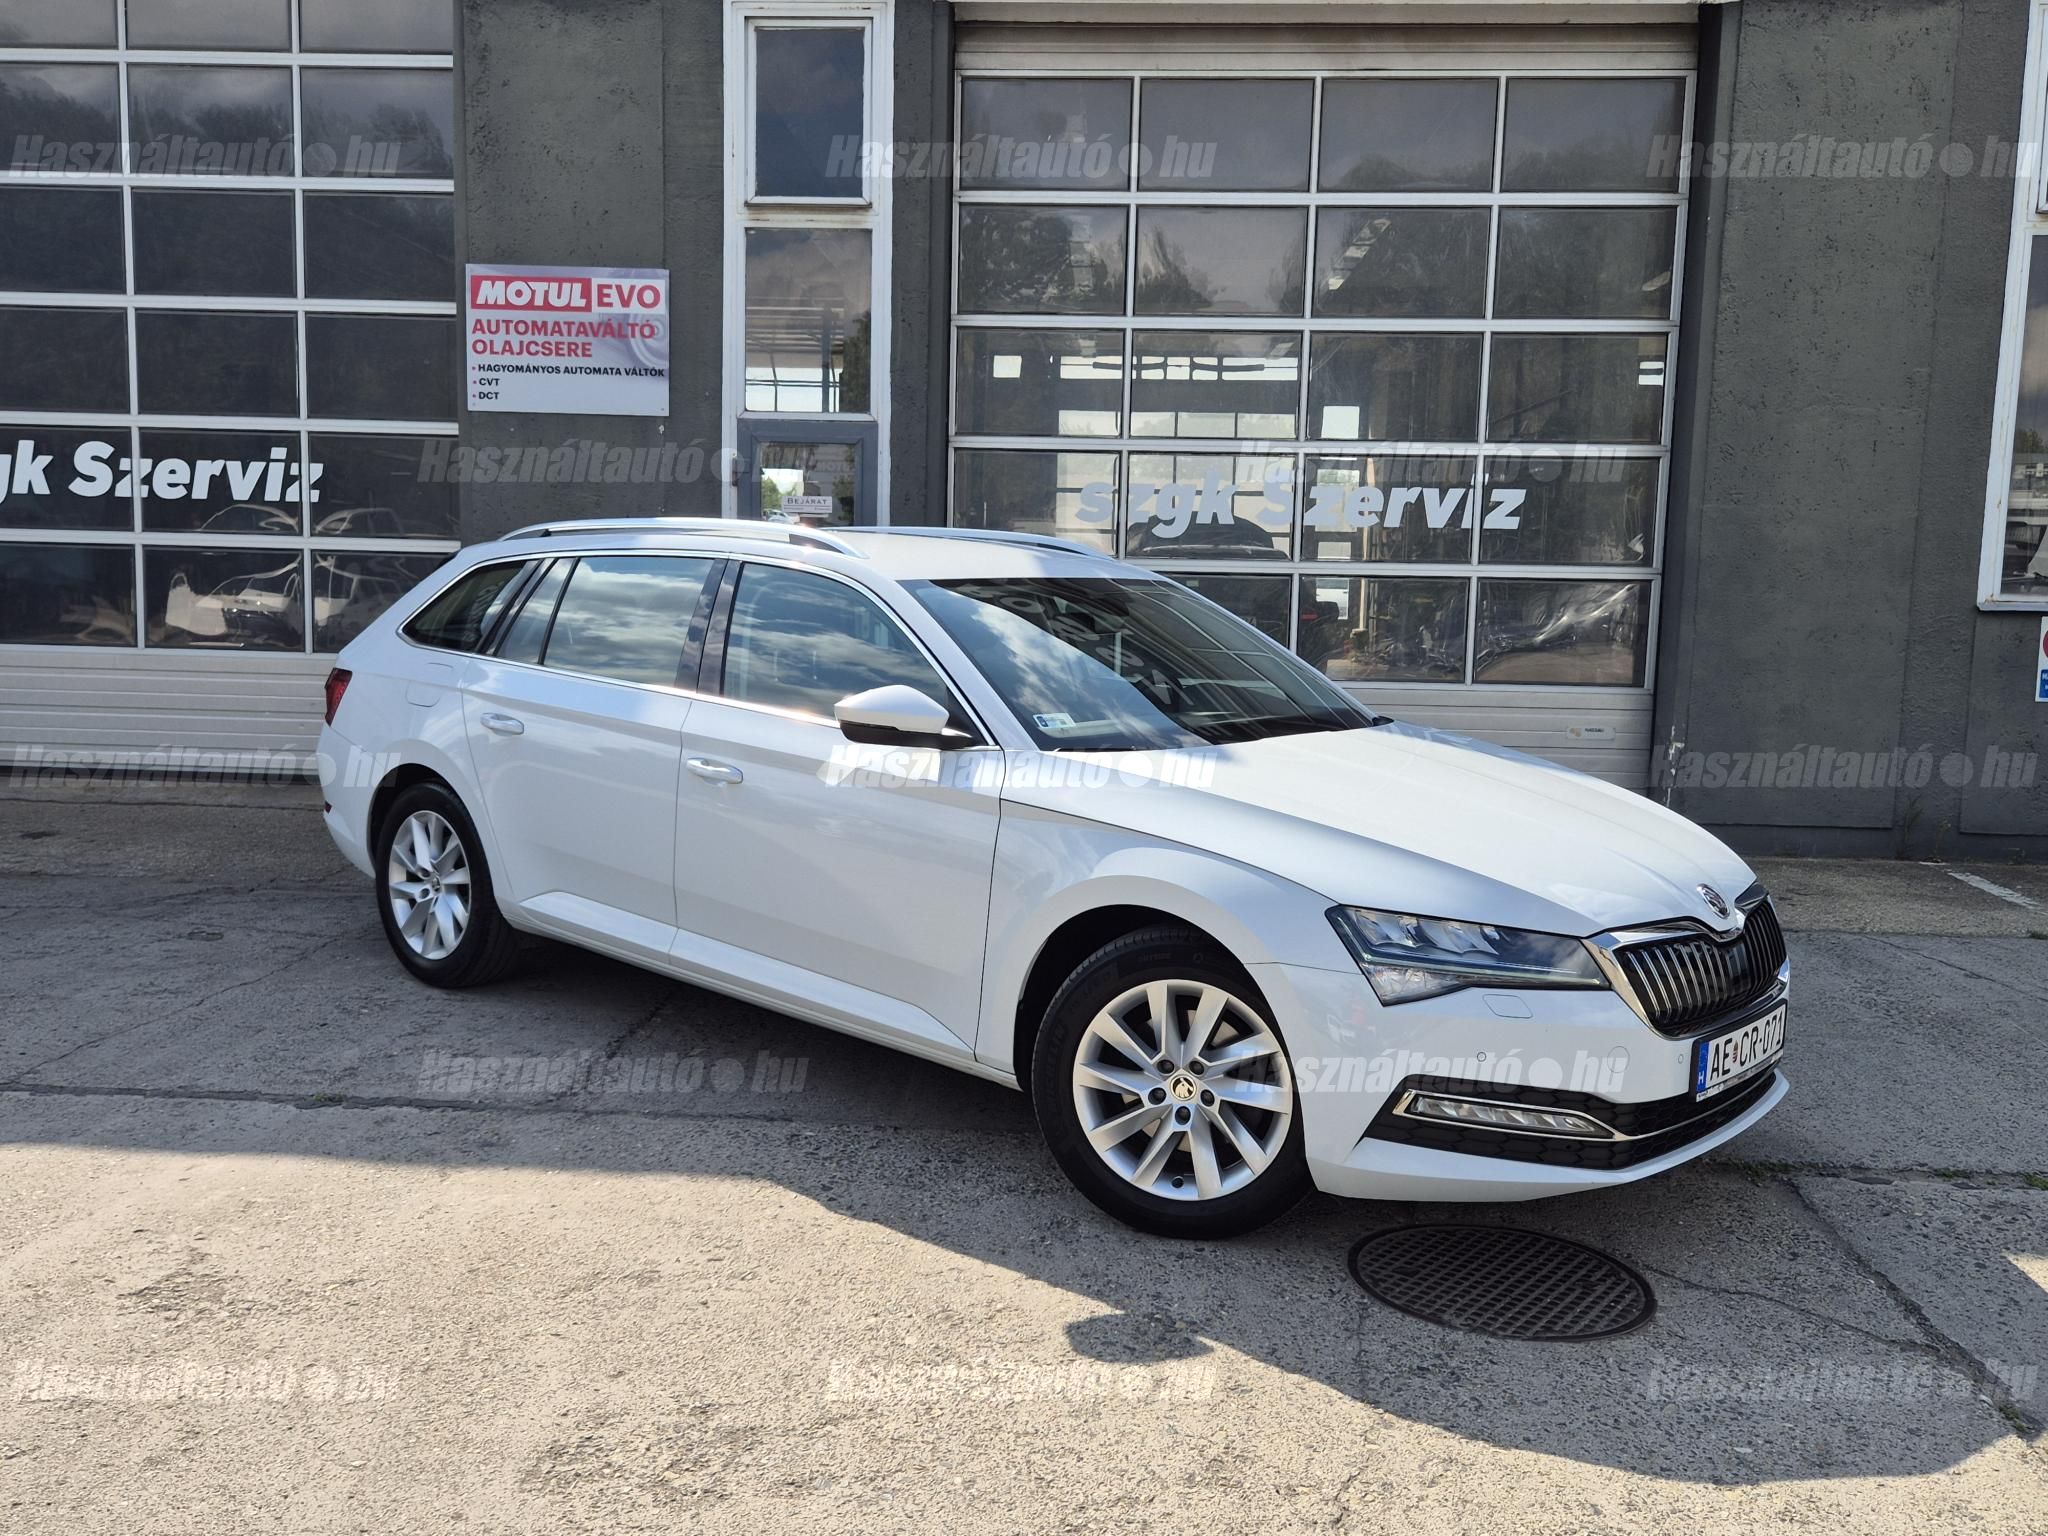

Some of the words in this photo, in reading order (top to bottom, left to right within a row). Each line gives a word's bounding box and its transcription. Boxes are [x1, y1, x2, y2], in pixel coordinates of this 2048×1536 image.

[476, 280, 587, 308] MOTUL
[596, 284, 661, 309] EVO
[472, 318, 656, 339] AUTOMATAVÁLTÓ
[472, 339, 593, 358] OLAJCSERE
[478, 363, 561, 375] HAGYOMÁNYOS
[563, 366, 622, 376] AUTOMATA
[624, 365, 665, 377] VÁLTÓK
[478, 378, 500, 387] CVT
[478, 391, 500, 400] DCT
[68, 440, 324, 503] Szerviz
[1075, 469, 1238, 539] szgk
[1256, 468, 1527, 530] Szerviz
[1710, 1038, 1732, 1080] AE
